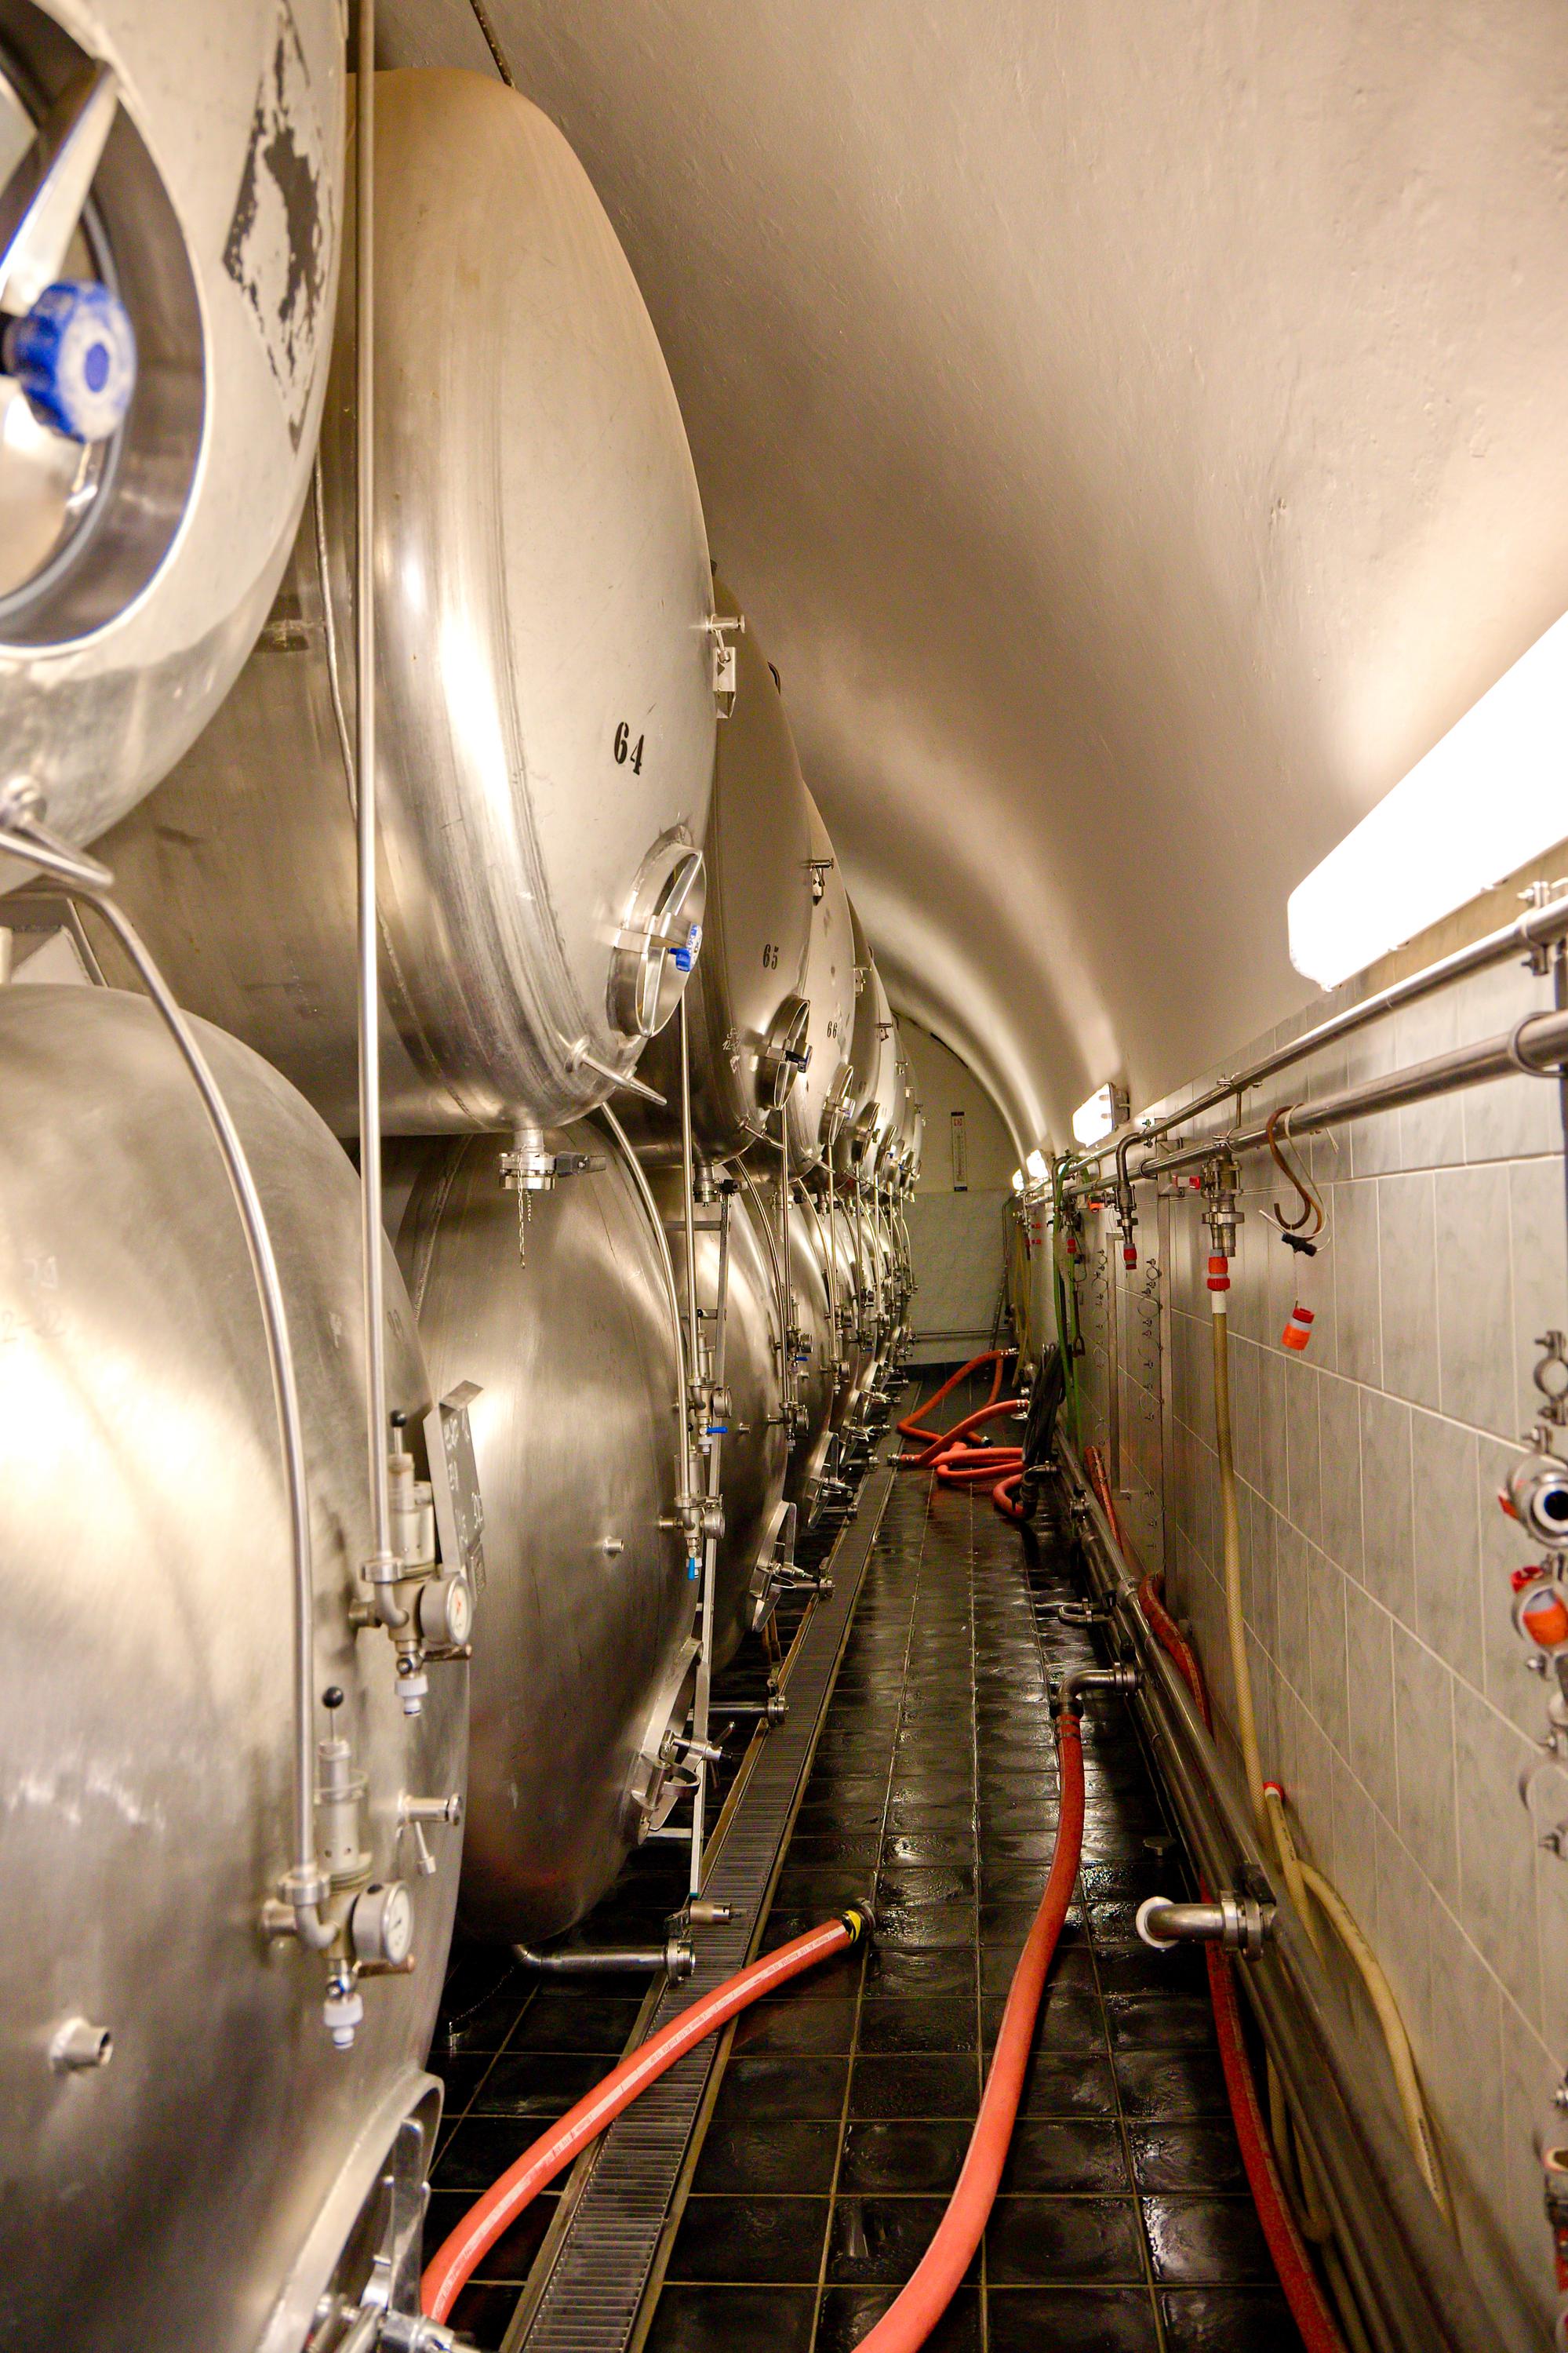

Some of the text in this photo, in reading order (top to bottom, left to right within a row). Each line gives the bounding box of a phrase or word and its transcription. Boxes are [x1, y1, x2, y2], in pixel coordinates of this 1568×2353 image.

[614, 722, 644, 776] 64
[763, 944, 779, 969] 65
[827, 1021, 838, 1038] 66
